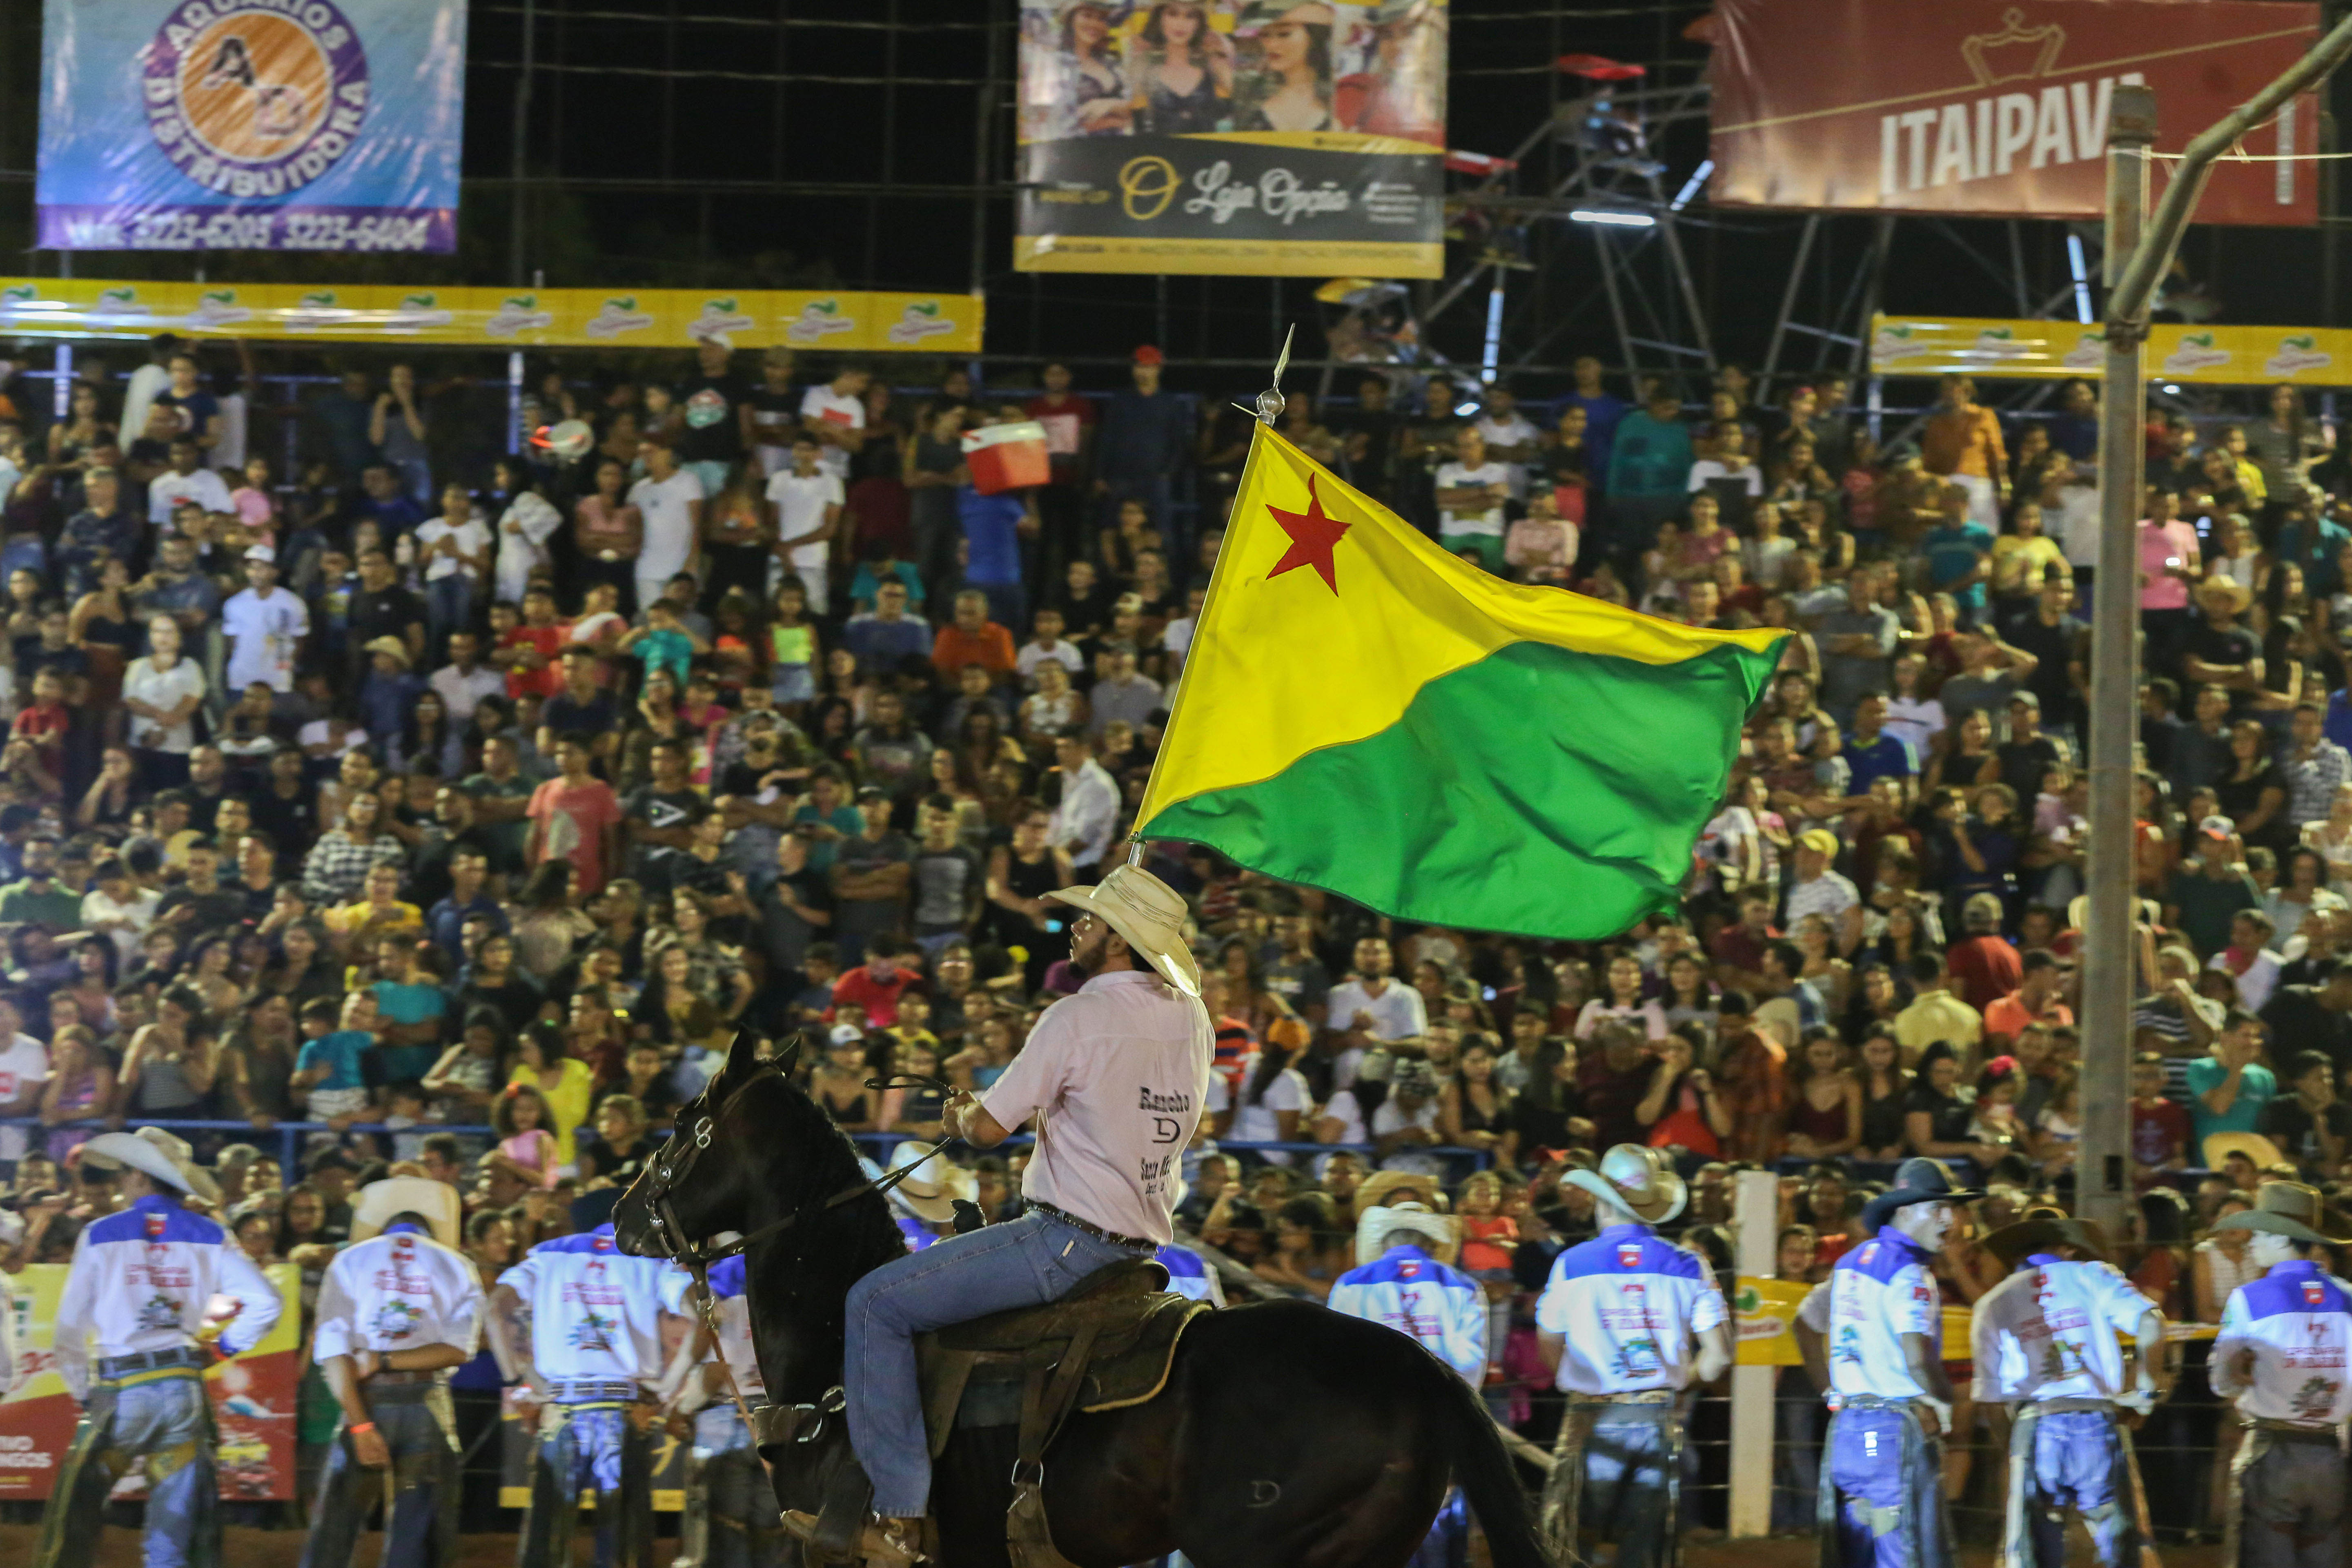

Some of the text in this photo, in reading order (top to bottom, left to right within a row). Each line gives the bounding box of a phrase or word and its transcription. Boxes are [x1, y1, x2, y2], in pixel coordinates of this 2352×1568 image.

[1880, 71, 2145, 196] ITAIPAV
[1185, 160, 1256, 225] Loja
[1138, 1086, 1190, 1114] Rancho
